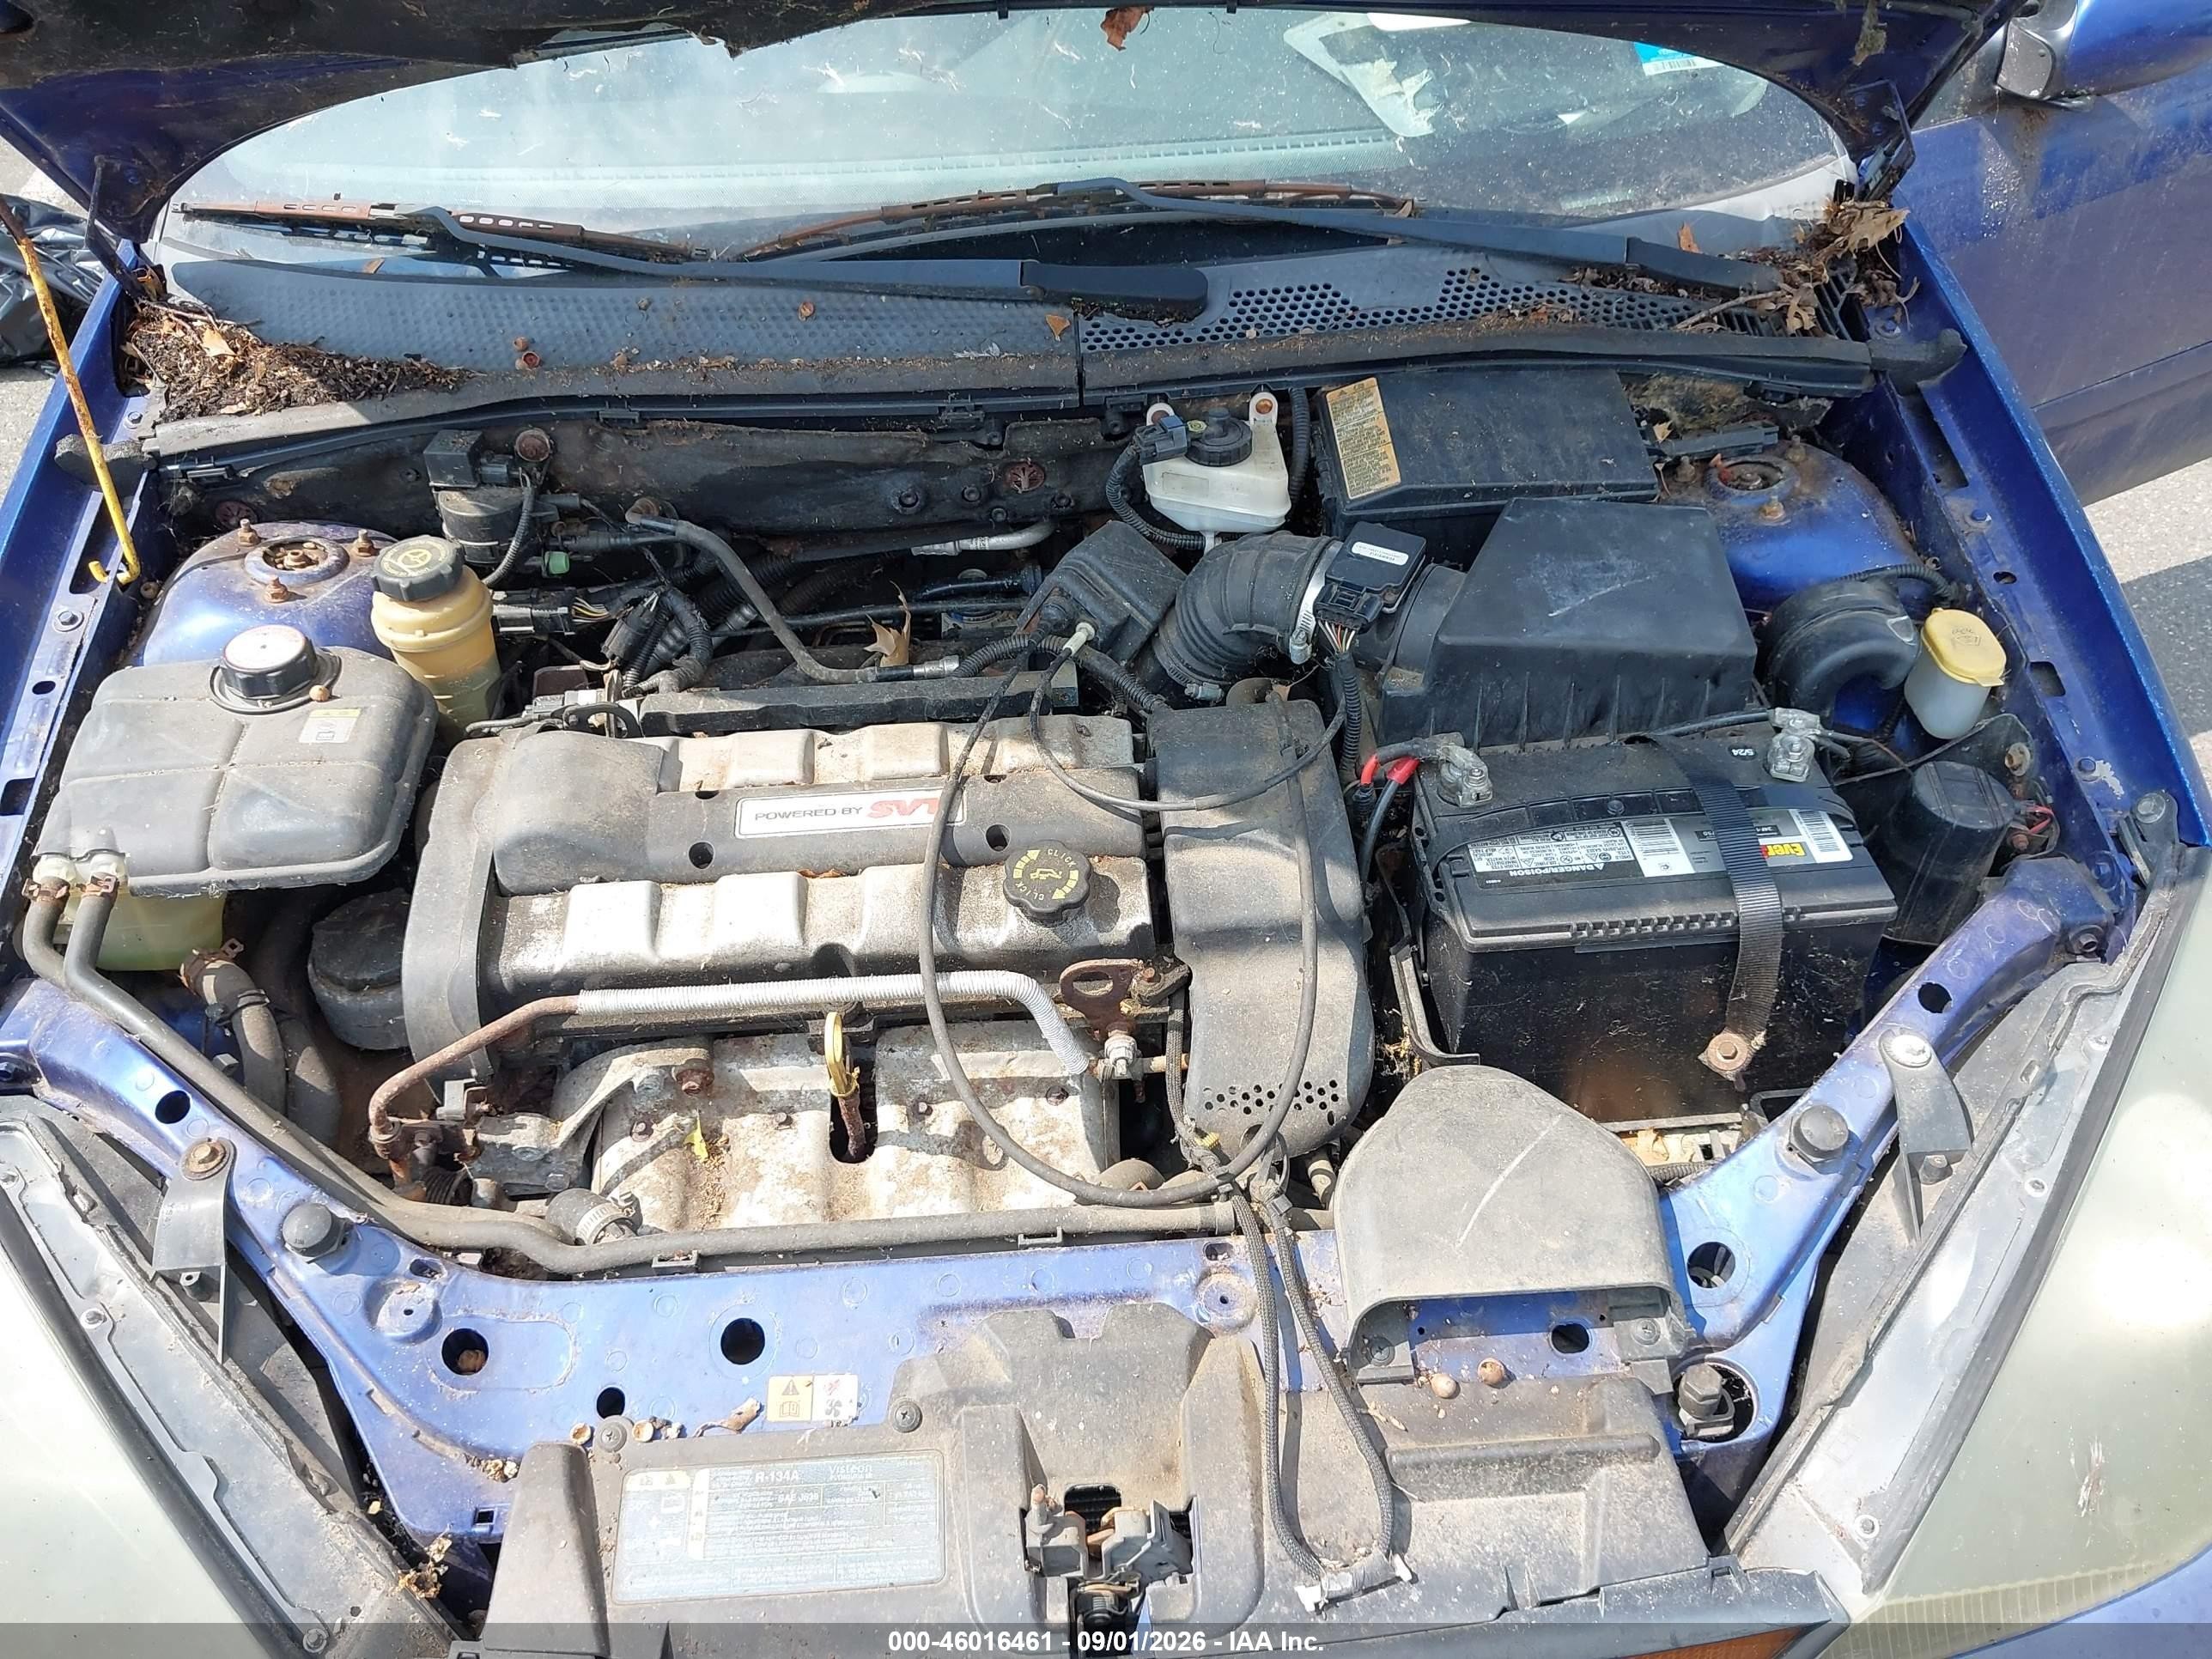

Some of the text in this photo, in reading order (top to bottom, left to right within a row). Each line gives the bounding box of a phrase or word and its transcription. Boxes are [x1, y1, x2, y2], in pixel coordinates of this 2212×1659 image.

[755, 808, 836, 821] POWERED
[1047, 848, 1077, 867] CLICK
[1509, 864, 1595, 877] DANGER/POISON
[1015, 881, 1044, 901] CLICK
[755, 1469, 799, 1483] R-134A
[829, 1464, 872, 1475] Visteon
